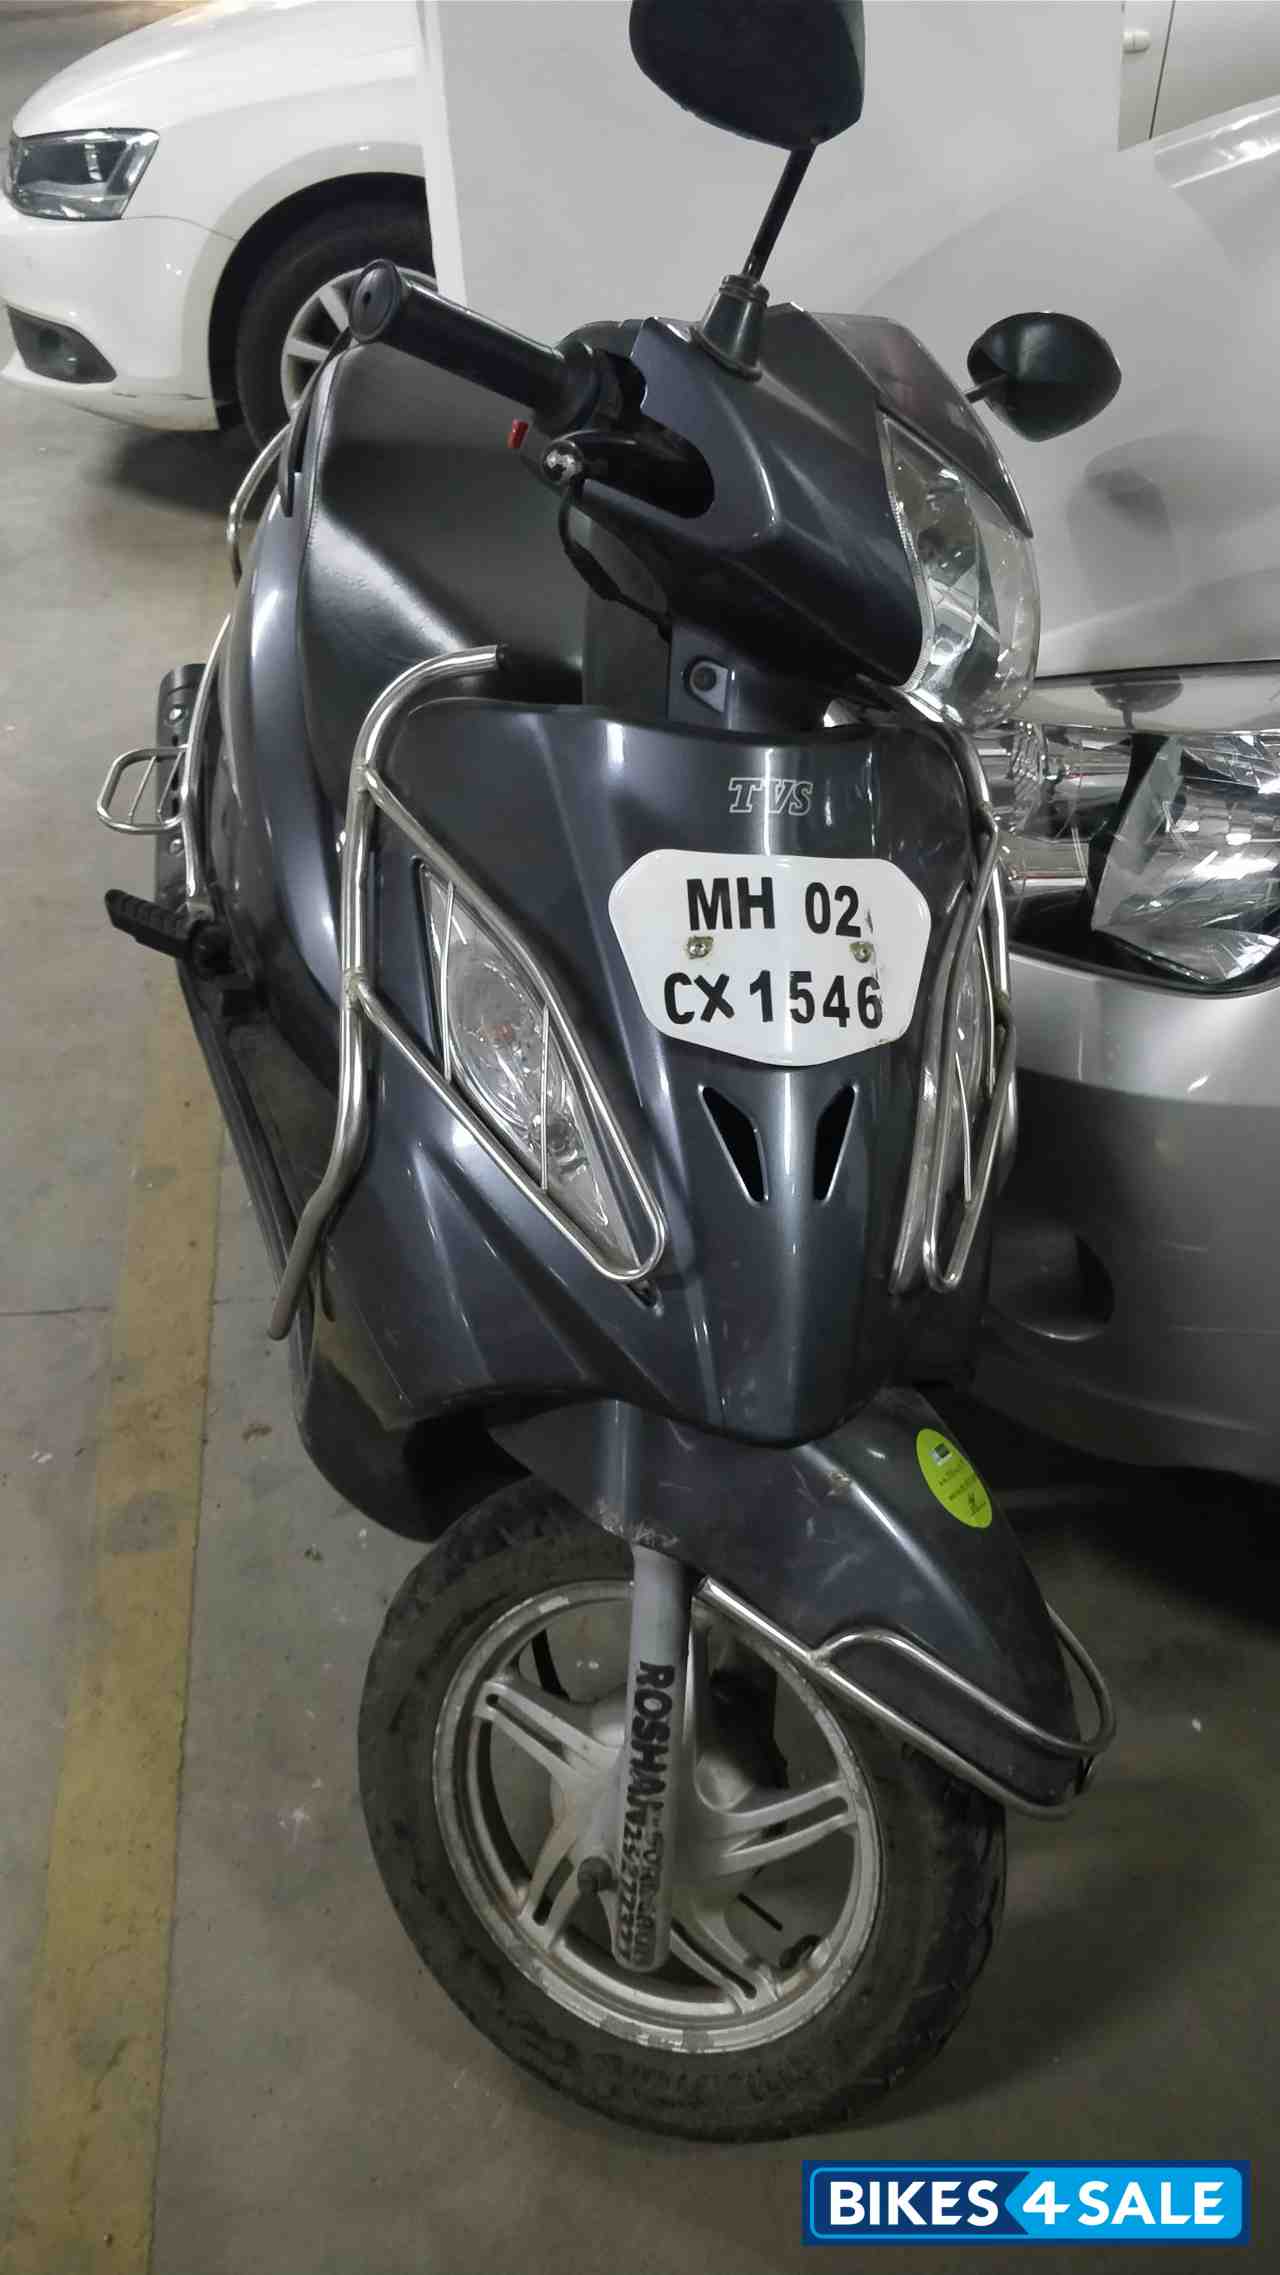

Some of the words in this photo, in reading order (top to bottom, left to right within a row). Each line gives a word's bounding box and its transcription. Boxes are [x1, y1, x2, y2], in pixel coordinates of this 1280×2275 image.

[728, 776, 813, 816] TVS
[686, 876, 775, 931] MH
[804, 881, 862, 938] 02
[663, 971, 735, 1025] CX
[749, 969, 883, 1029] 1546
